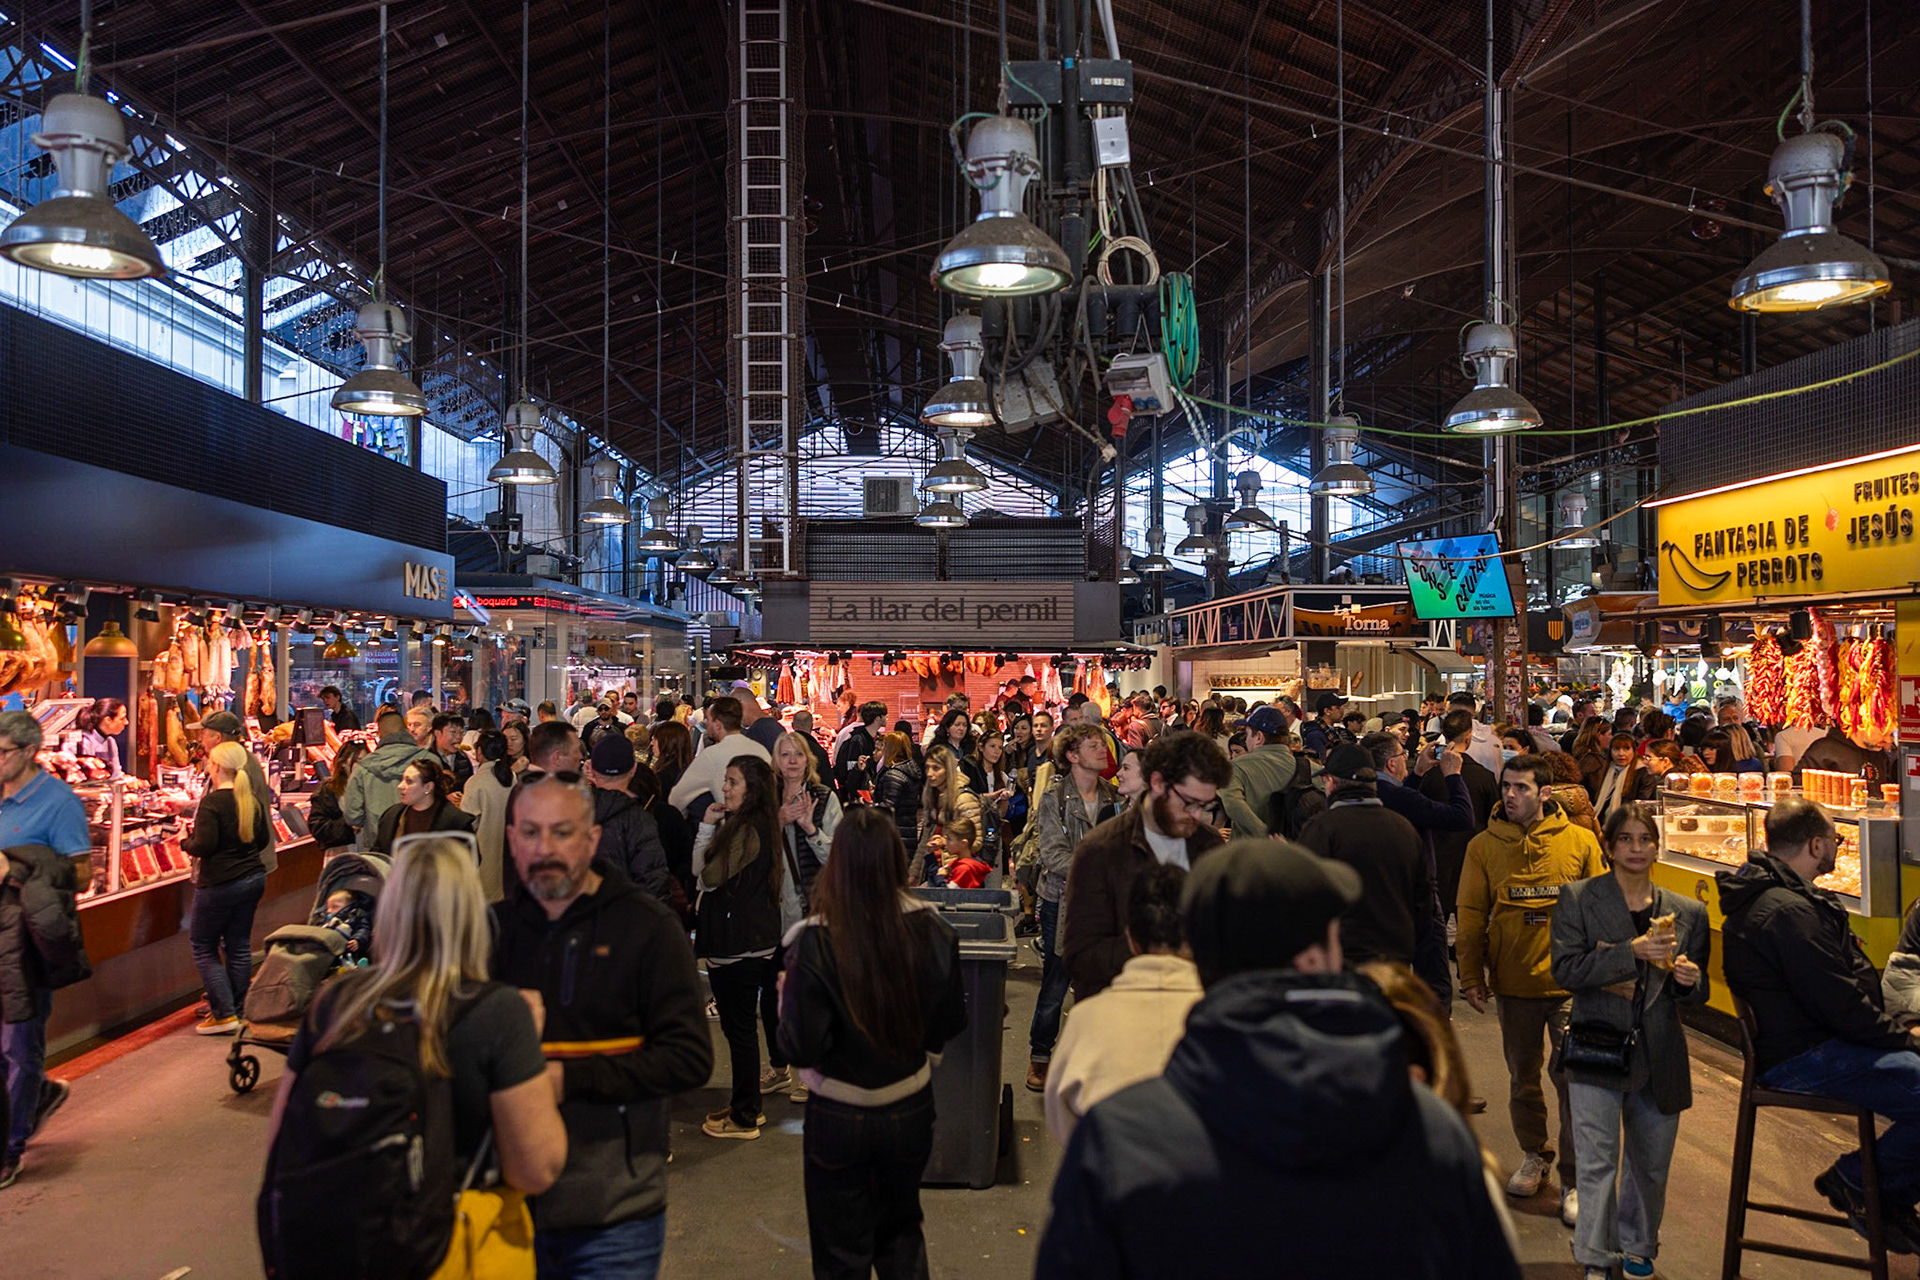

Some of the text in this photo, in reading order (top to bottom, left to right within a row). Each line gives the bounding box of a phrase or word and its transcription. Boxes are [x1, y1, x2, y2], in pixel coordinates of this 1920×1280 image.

[1854, 471, 1920, 503] FRUITES
[1694, 514, 1810, 559] FANTASIA DE
[1847, 504, 1914, 545] JESÚS
[403, 561, 439, 601] MAS
[1410, 554, 1447, 601] SONS
[1438, 552, 1458, 580] DE
[1455, 548, 1488, 612] CIUTAT
[1737, 552, 1823, 588] PEBROTS
[827, 596, 1058, 629] La llar del pernil
[1333, 604, 1350, 616] La
[1342, 615, 1391, 630] Torna
